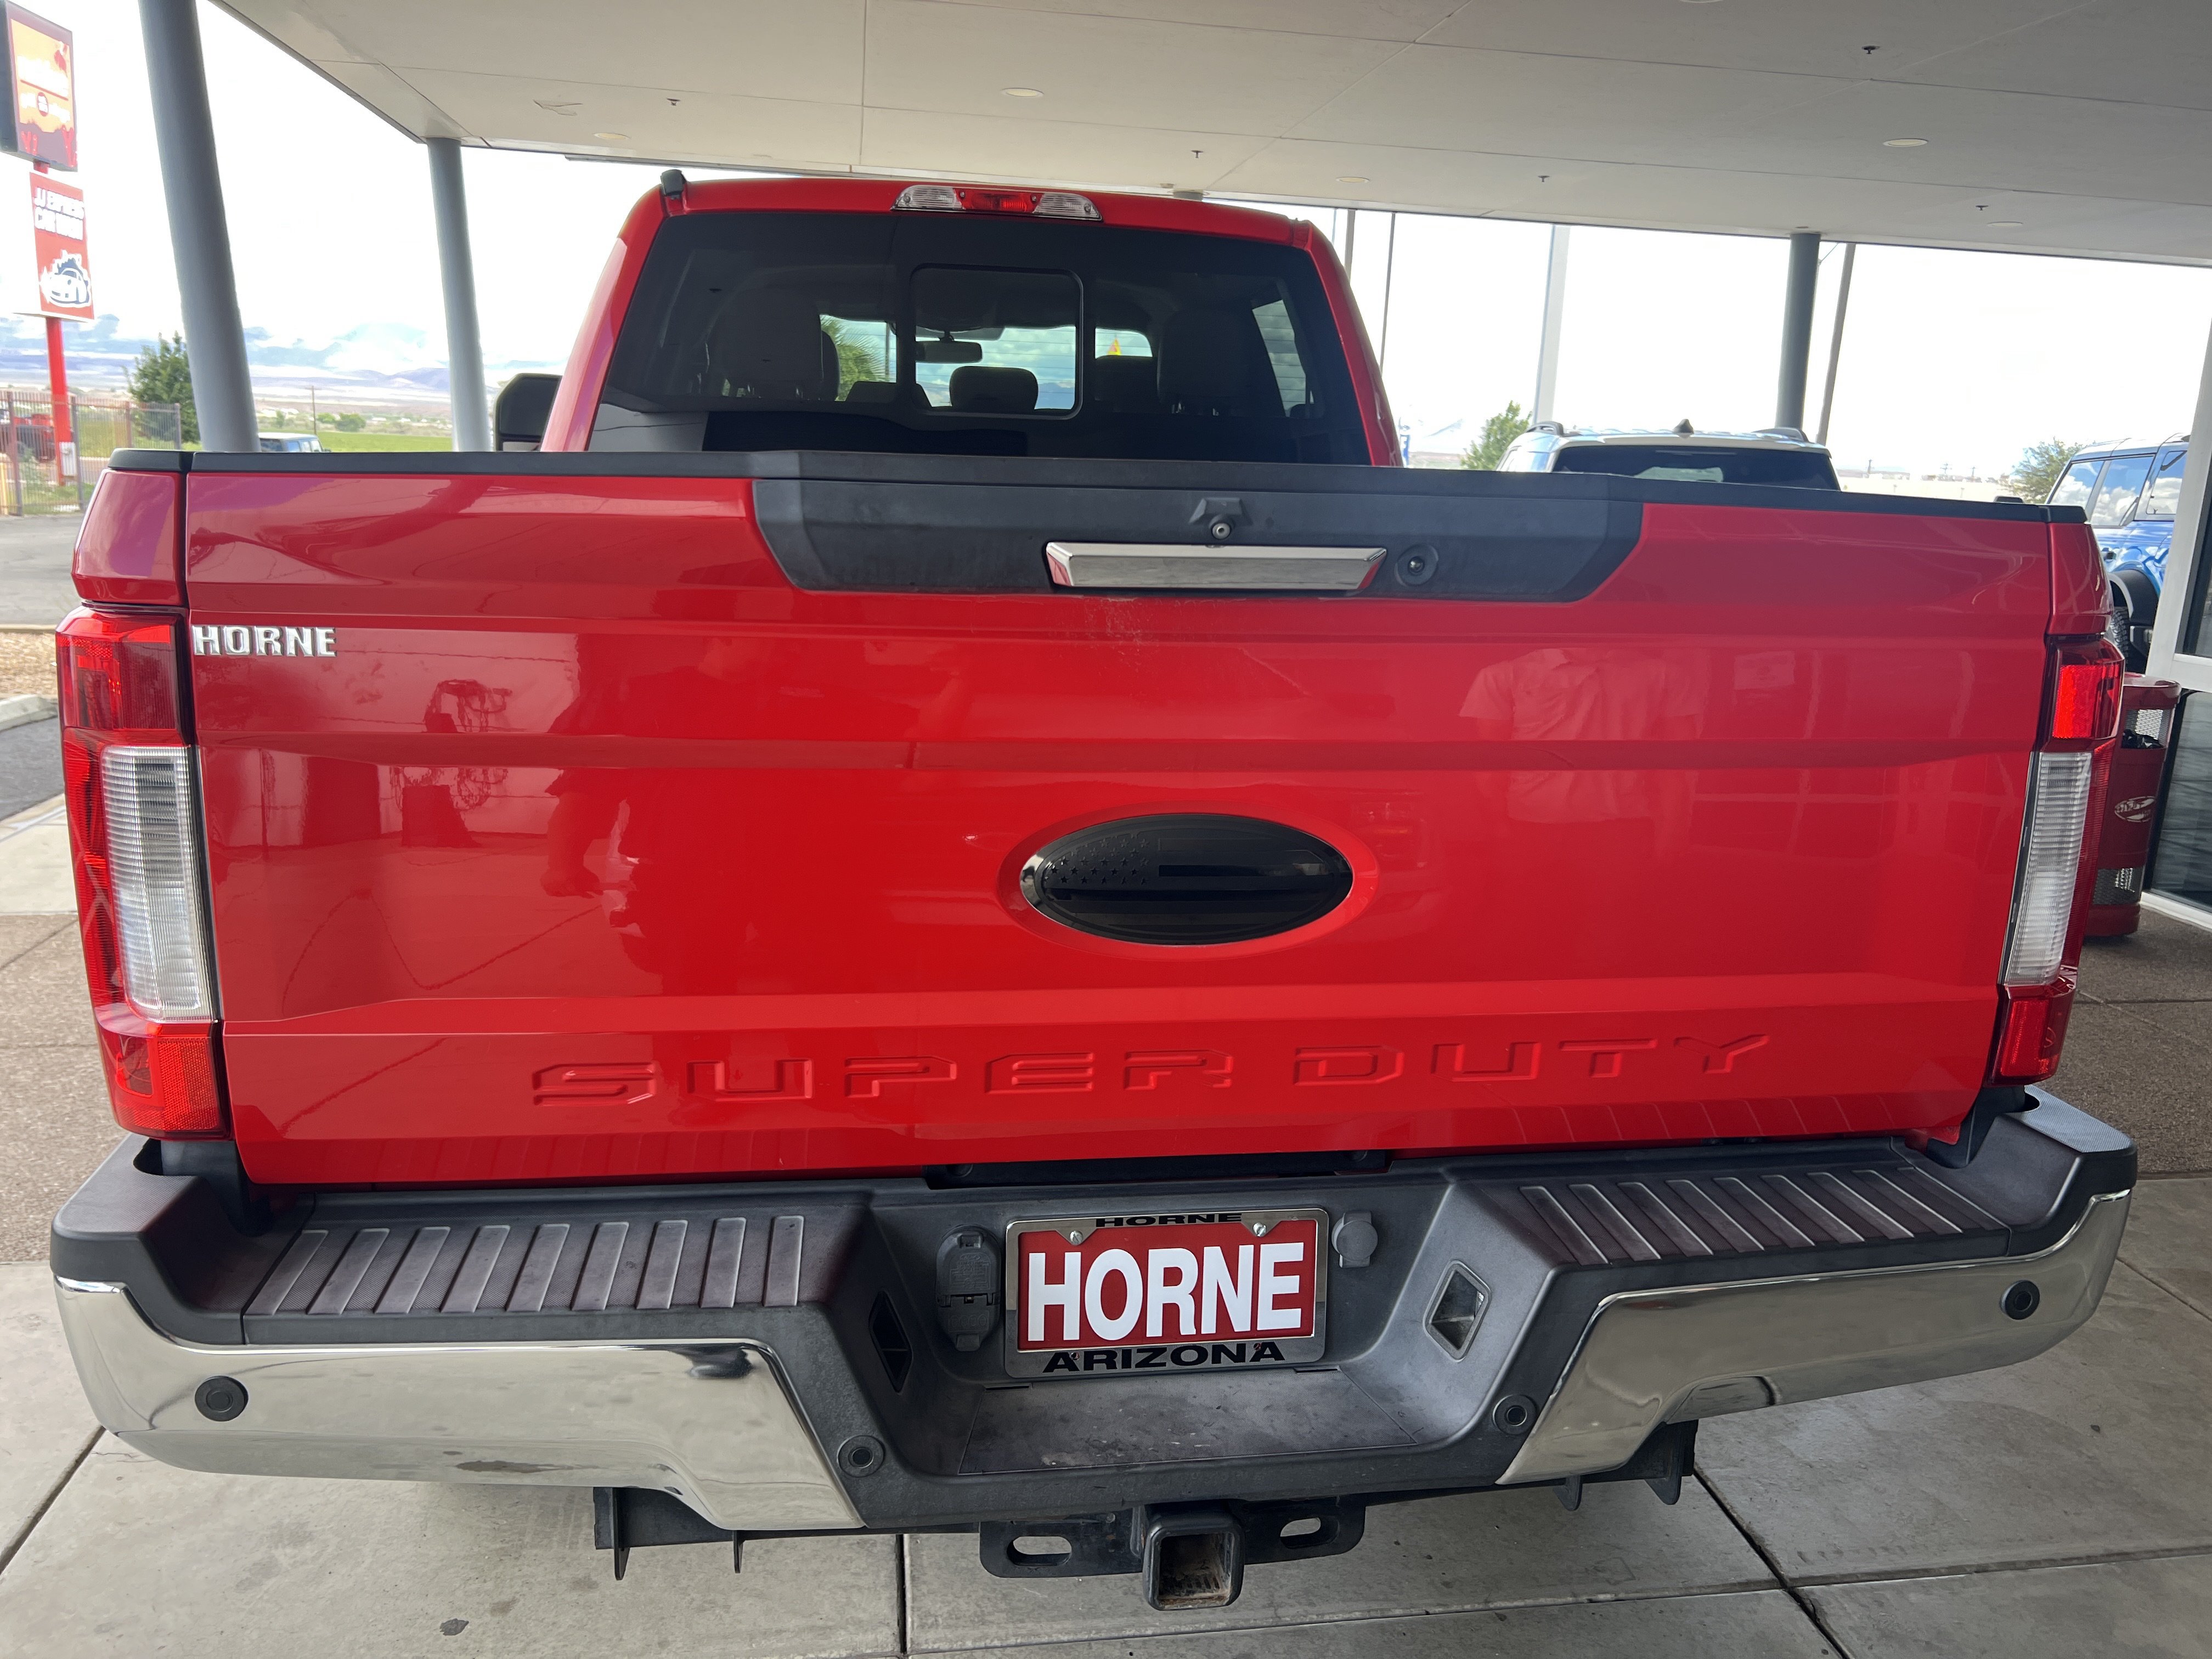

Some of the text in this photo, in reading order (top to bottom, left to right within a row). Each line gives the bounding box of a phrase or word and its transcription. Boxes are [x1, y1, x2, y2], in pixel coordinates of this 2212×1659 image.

[192, 625, 337, 657] HORNE
[532, 1034, 1770, 1107] SUPER DUTY
[1096, 1213, 1242, 1228] HORNE
[1028, 1242, 1305, 1342] HORNE
[1042, 1341, 1285, 1373] ARIZONA
